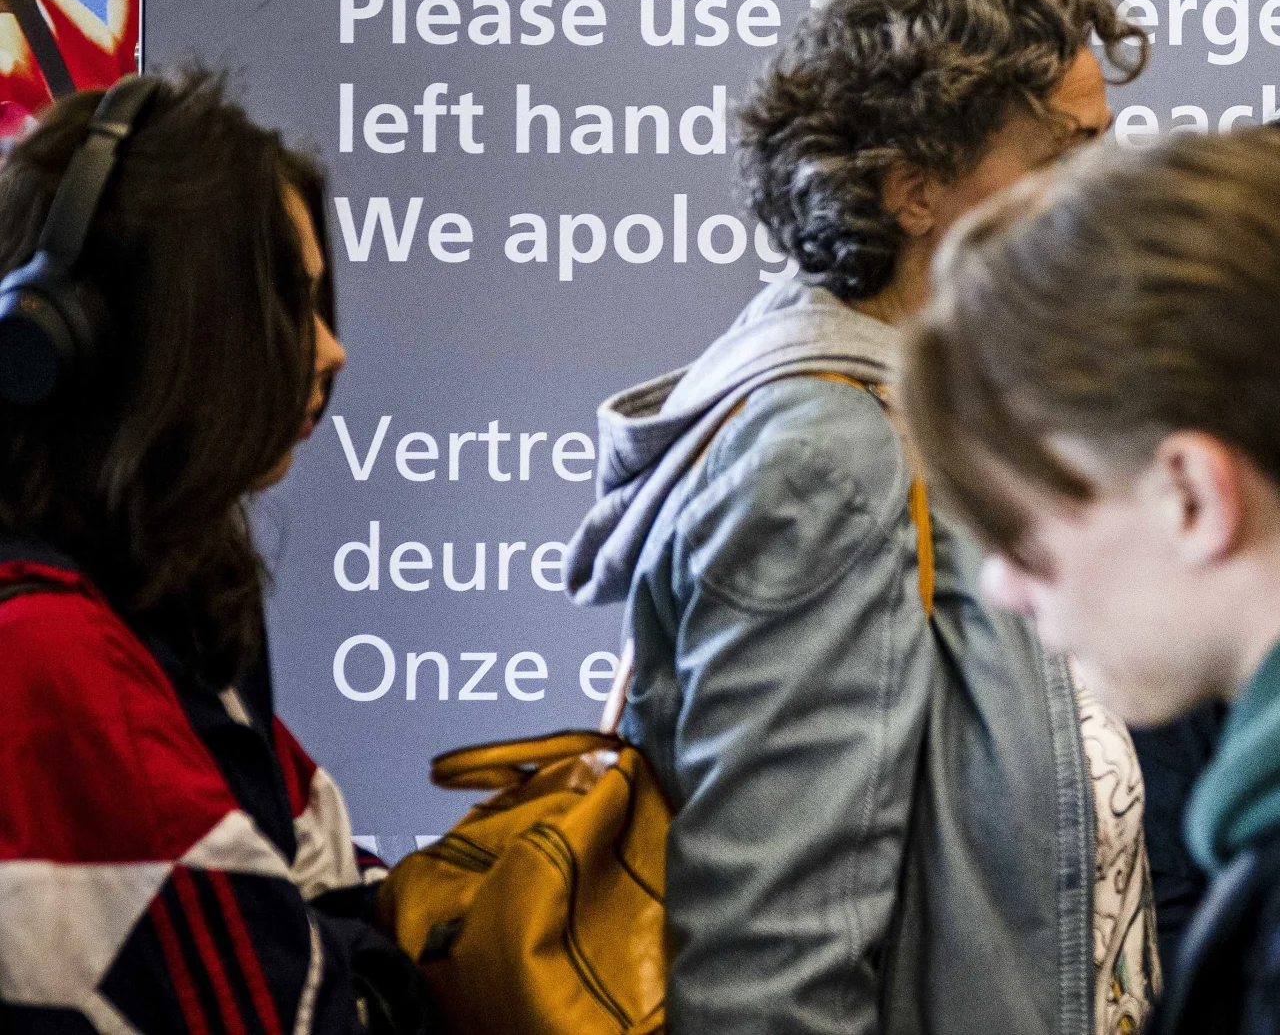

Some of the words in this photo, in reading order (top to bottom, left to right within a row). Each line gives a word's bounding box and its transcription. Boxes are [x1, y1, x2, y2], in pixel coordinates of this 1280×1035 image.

[340, 83, 484, 153] left
[516, 84, 726, 154] hand
[335, 197, 473, 263] We
[332, 416, 596, 482] Vertre
[333, 521, 568, 592] deure
[332, 634, 548, 702] Onze
